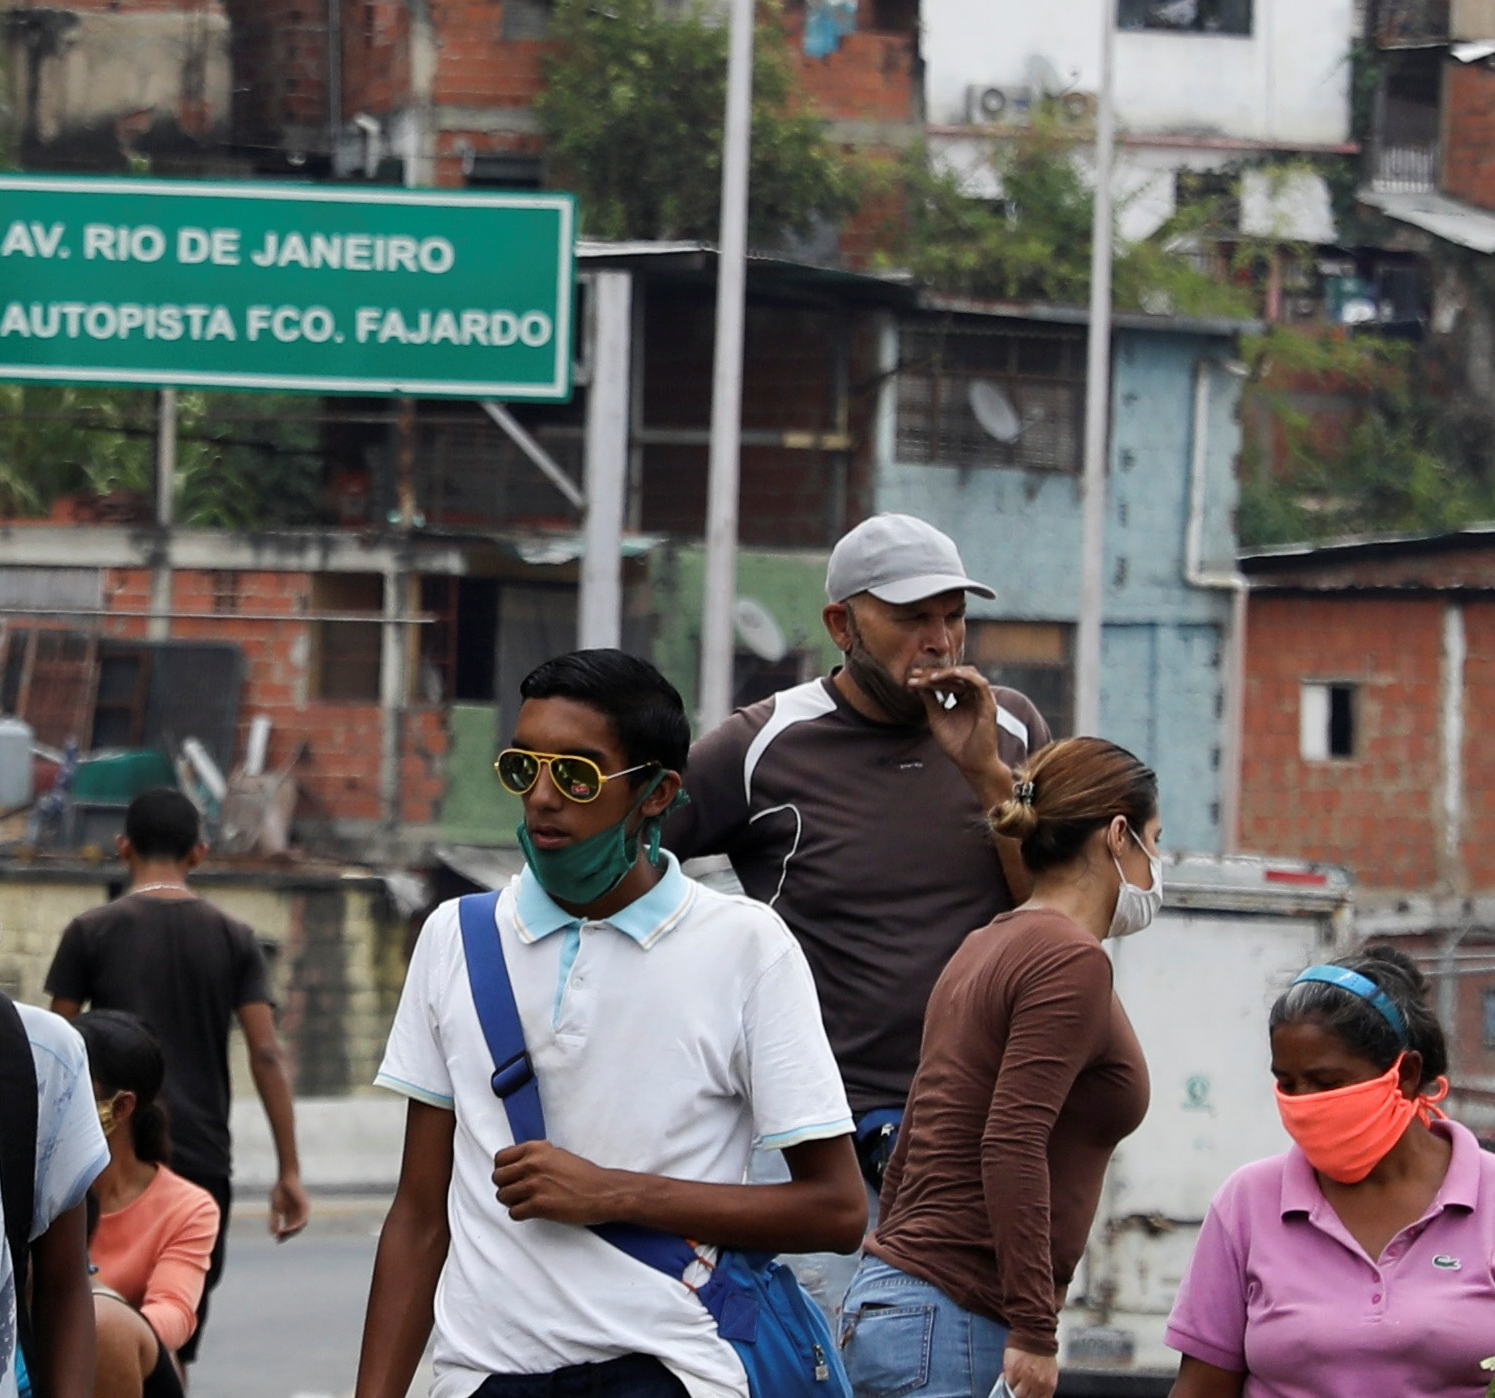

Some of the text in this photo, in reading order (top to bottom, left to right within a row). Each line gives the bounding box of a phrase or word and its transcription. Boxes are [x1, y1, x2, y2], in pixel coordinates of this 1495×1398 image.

[0, 221, 456, 275] AV. RIO DE JANEIRO
[247, 306, 345, 345] FCO.
[356, 309, 552, 348] FAJARDO
